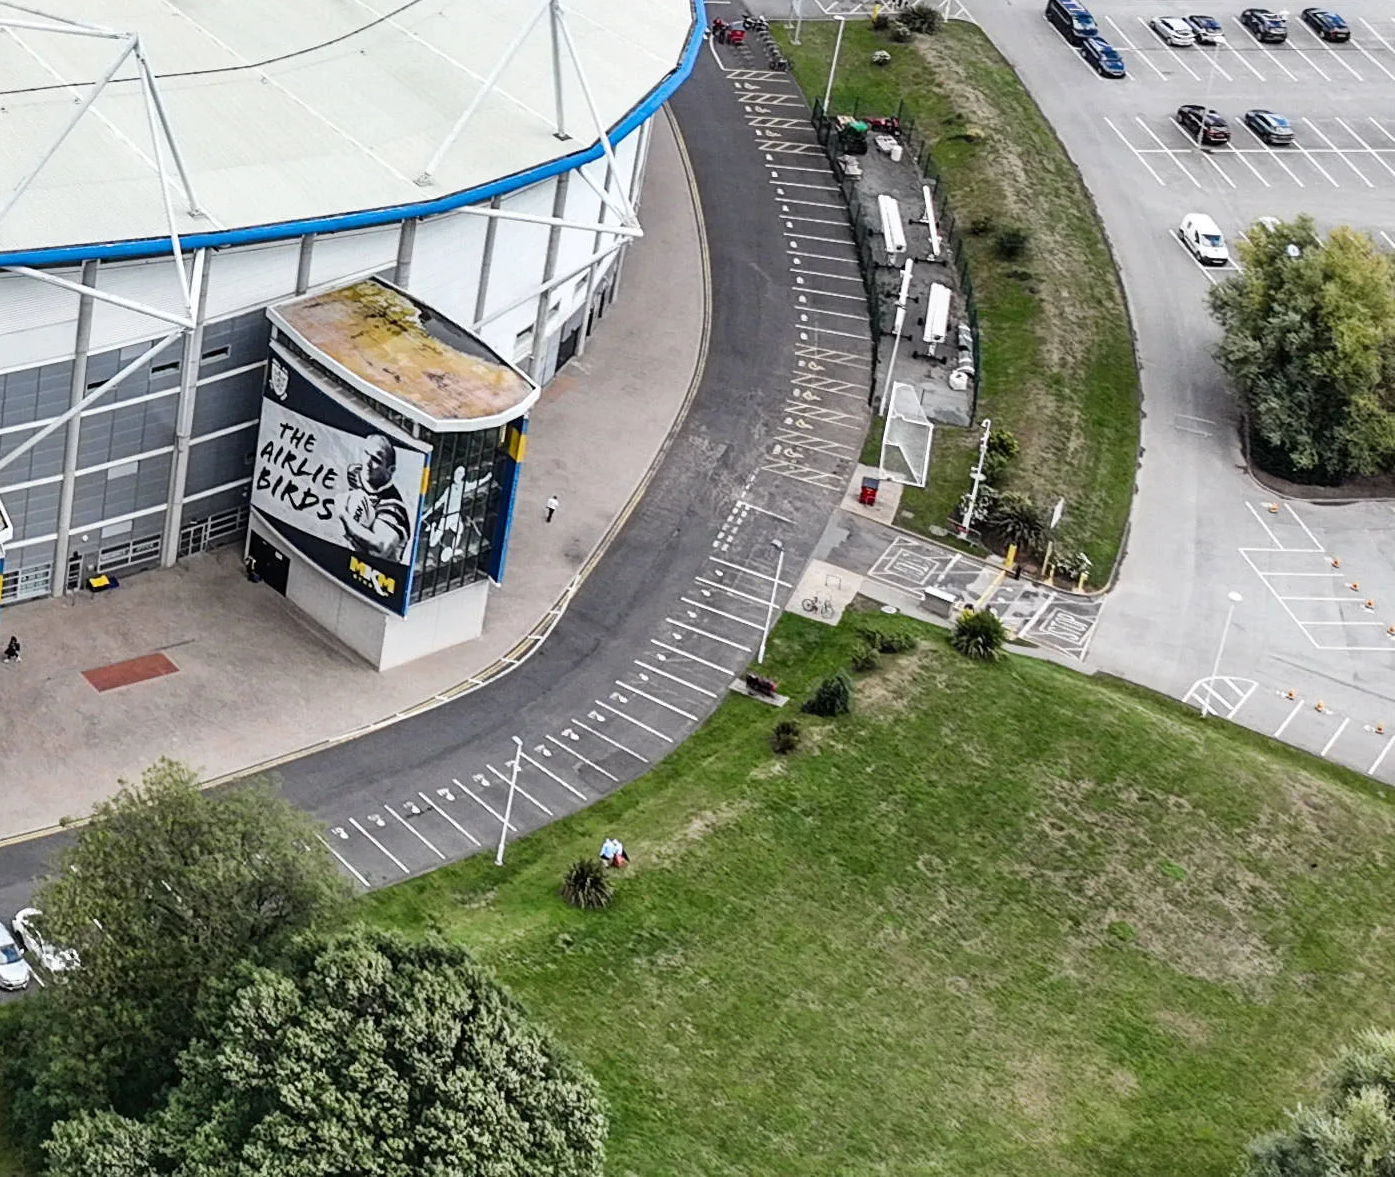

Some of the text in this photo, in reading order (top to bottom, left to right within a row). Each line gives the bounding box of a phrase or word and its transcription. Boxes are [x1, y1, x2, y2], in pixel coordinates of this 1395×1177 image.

[280, 422, 317, 453] THE
[260, 441, 339, 490] AIRLIE
[257, 466, 335, 521] BIRDS
[349, 555, 396, 597] MKM
